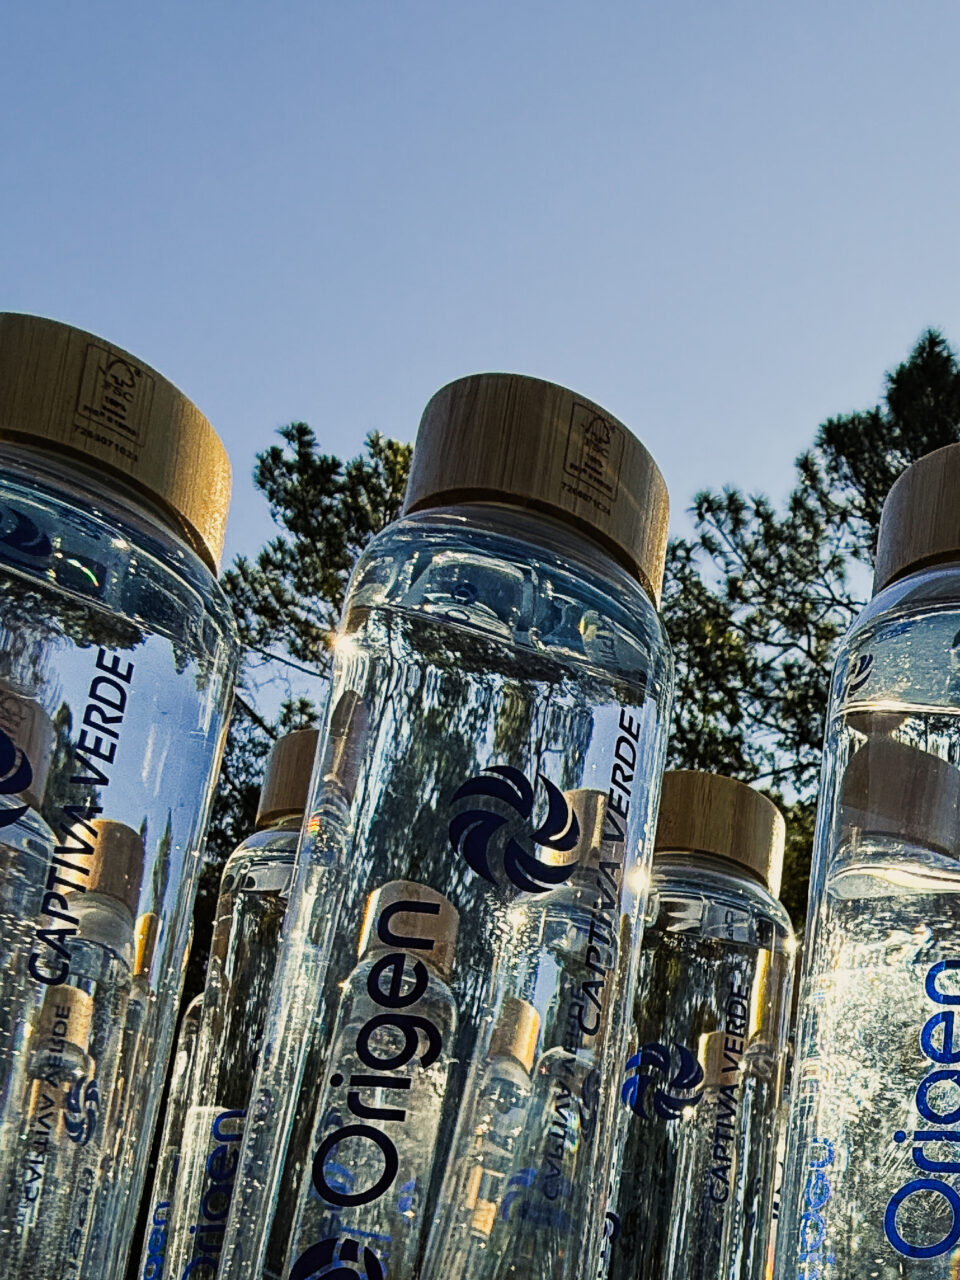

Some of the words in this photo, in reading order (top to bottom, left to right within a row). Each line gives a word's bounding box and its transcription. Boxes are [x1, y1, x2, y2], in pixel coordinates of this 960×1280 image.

[28, 800, 104, 986] CAPTIVA
[72, 646, 135, 787] VERDE
[576, 860, 622, 1036] CAPTIVA
[604, 703, 643, 845] VERDE
[309, 895, 445, 1208] Origen
[709, 1083, 740, 1204] CAPTIVA
[721, 983, 750, 1074] VERDE
